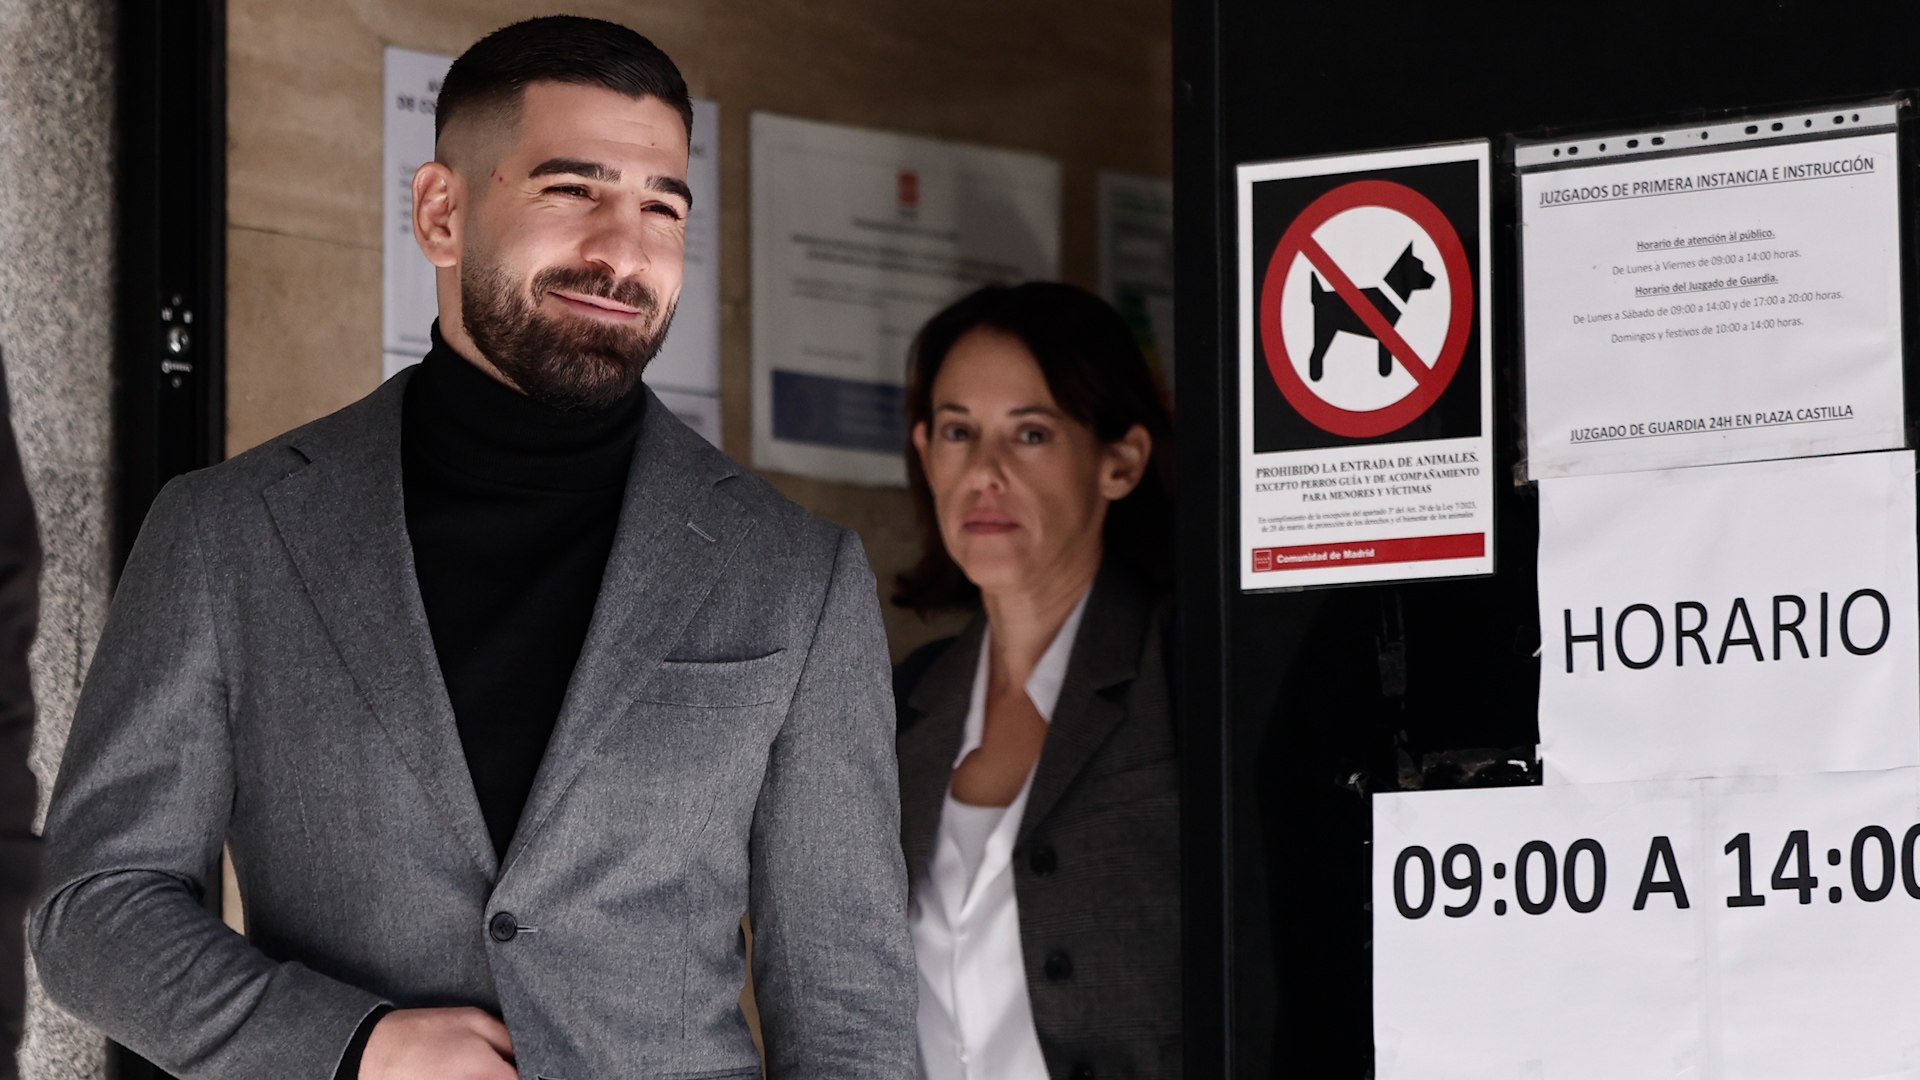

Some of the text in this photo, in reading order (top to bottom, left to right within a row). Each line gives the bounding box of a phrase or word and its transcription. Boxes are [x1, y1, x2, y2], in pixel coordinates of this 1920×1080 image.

[1539, 153, 1874, 206] JUZGADOS DE PRIMERA INSTANCIA E INSTRUCCIÓN
[1636, 228, 1775, 251] Horario de atención al público.
[1612, 247, 1801, 276] De Lunes a Viernes de 09:00 a 14:00 horas.
[1635, 272, 1778, 296] Horario del Juzgado de Guardia.
[1572, 289, 1843, 325] De Lunes a Sábado de 09:00 a 14:00 y de 17:00 a 20:00 horas.
[1611, 315, 1804, 346] Domingos y festivos de 10:00 a 14:00 horas.
[1569, 404, 1854, 442] JUZGADO DE GUARDIA 24H EN PLAZA CASTILLA
[1255, 452, 1479, 479] PROHIBIDO LA ENTRADA DE ANIMALES.
[1255, 466, 1480, 493] EXCEPTO PERROS GUÍA Y DE ACOMPAÑAMIENTO
[1302, 483, 1432, 503] PARA MENORES Y VÍCTIMAS
[1276, 551, 1328, 564] Comunidad
[1329, 550, 1341, 561] de
[1342, 548, 1375, 560] Madrid
[1564, 588, 1891, 674] HORARIO
[1393, 838, 1607, 920] 09:00
[1633, 836, 1690, 912] A
